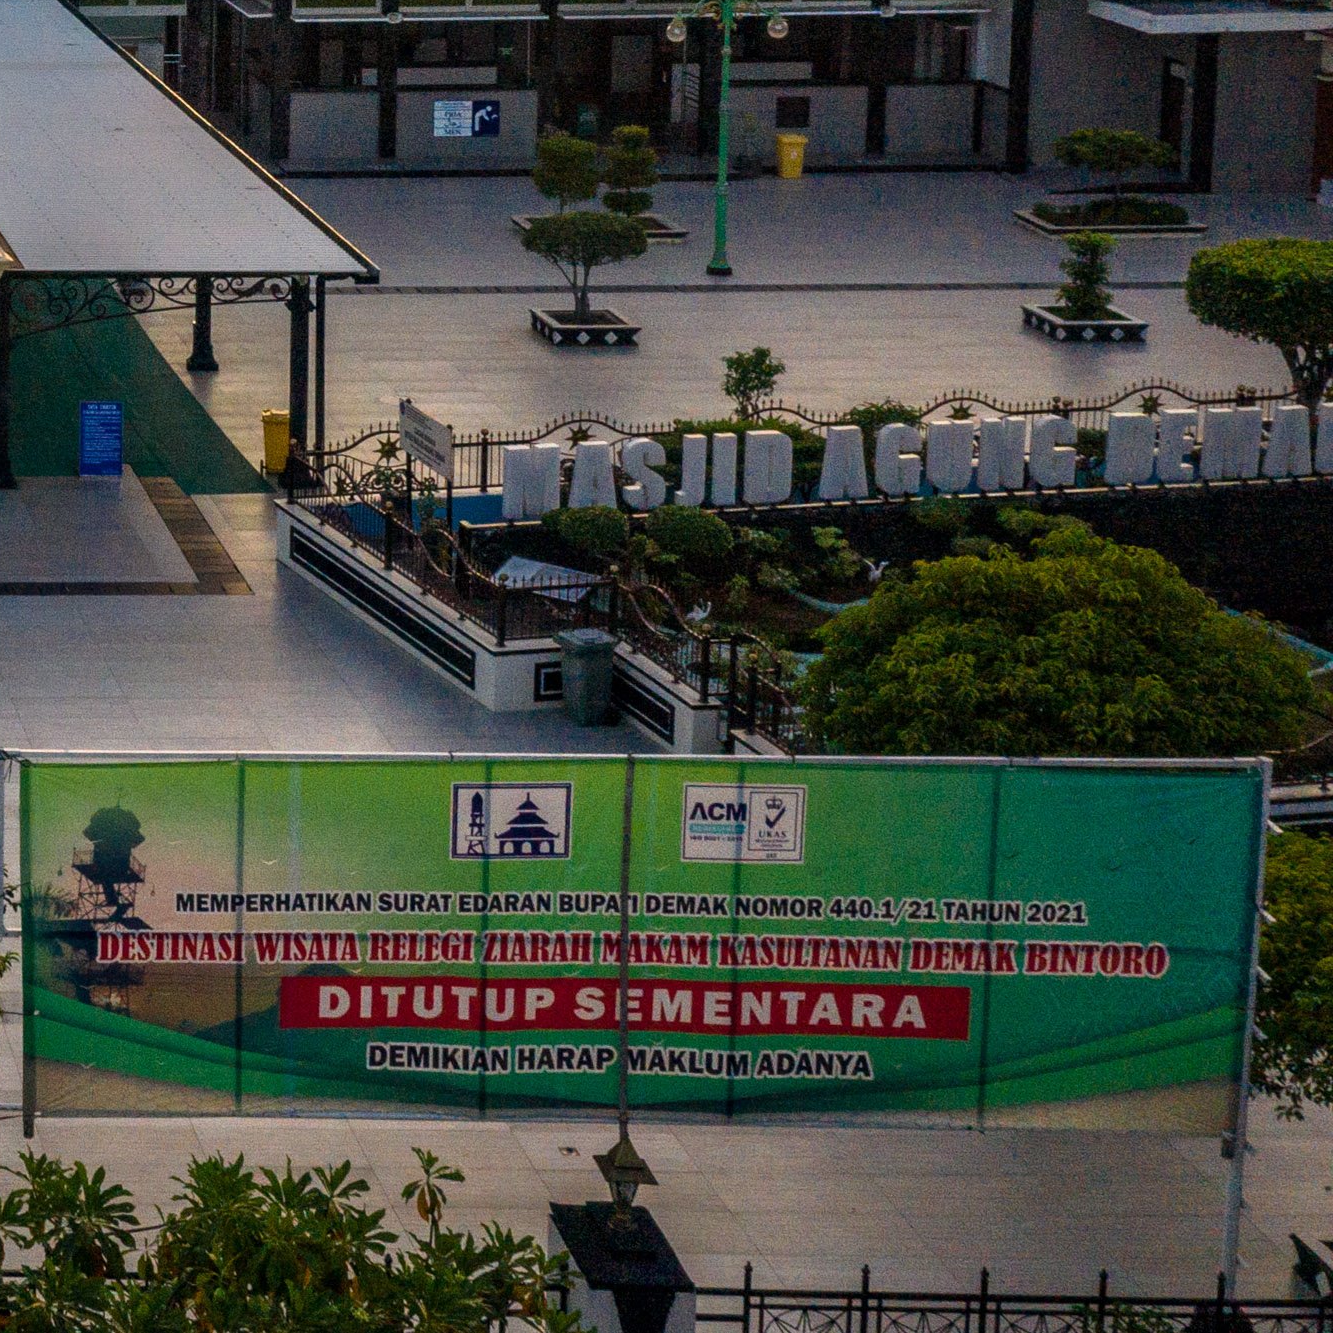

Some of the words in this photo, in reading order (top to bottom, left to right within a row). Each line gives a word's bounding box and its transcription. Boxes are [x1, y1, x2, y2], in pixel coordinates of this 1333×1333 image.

[502, 429, 794, 519] MASJID
[818, 413, 1077, 499] AGUNG
[689, 801, 748, 822] ACM
[174, 892, 372, 913] MEMPERHATIKAN
[377, 893, 452, 914] SURAT
[458, 893, 551, 914] EDARAN
[644, 894, 727, 916] DEMAK
[734, 896, 823, 918] NOMOR
[829, 898, 936, 923] 440.1/21
[942, 900, 1021, 923] TAHUN
[1026, 902, 1087, 925] 2021
[98, 931, 245, 962] DESTINASI
[253, 931, 359, 962] WISATA
[368, 931, 475, 962] RELEGI
[483, 931, 592, 963] ZIARAH
[601, 932, 710, 965] MAKAM
[718, 934, 902, 969] KASULTANAN
[909, 939, 1017, 973] DEMAK
[1023, 941, 1170, 976] BINTORO
[318, 984, 555, 1022] DITUTUP
[573, 986, 927, 1029] SEMENTARA
[368, 1044, 510, 1073] DEMIKIAN
[516, 1046, 615, 1073] HARAP
[626, 1047, 750, 1078] MAKLUM
[755, 1051, 874, 1080] ADANYA
